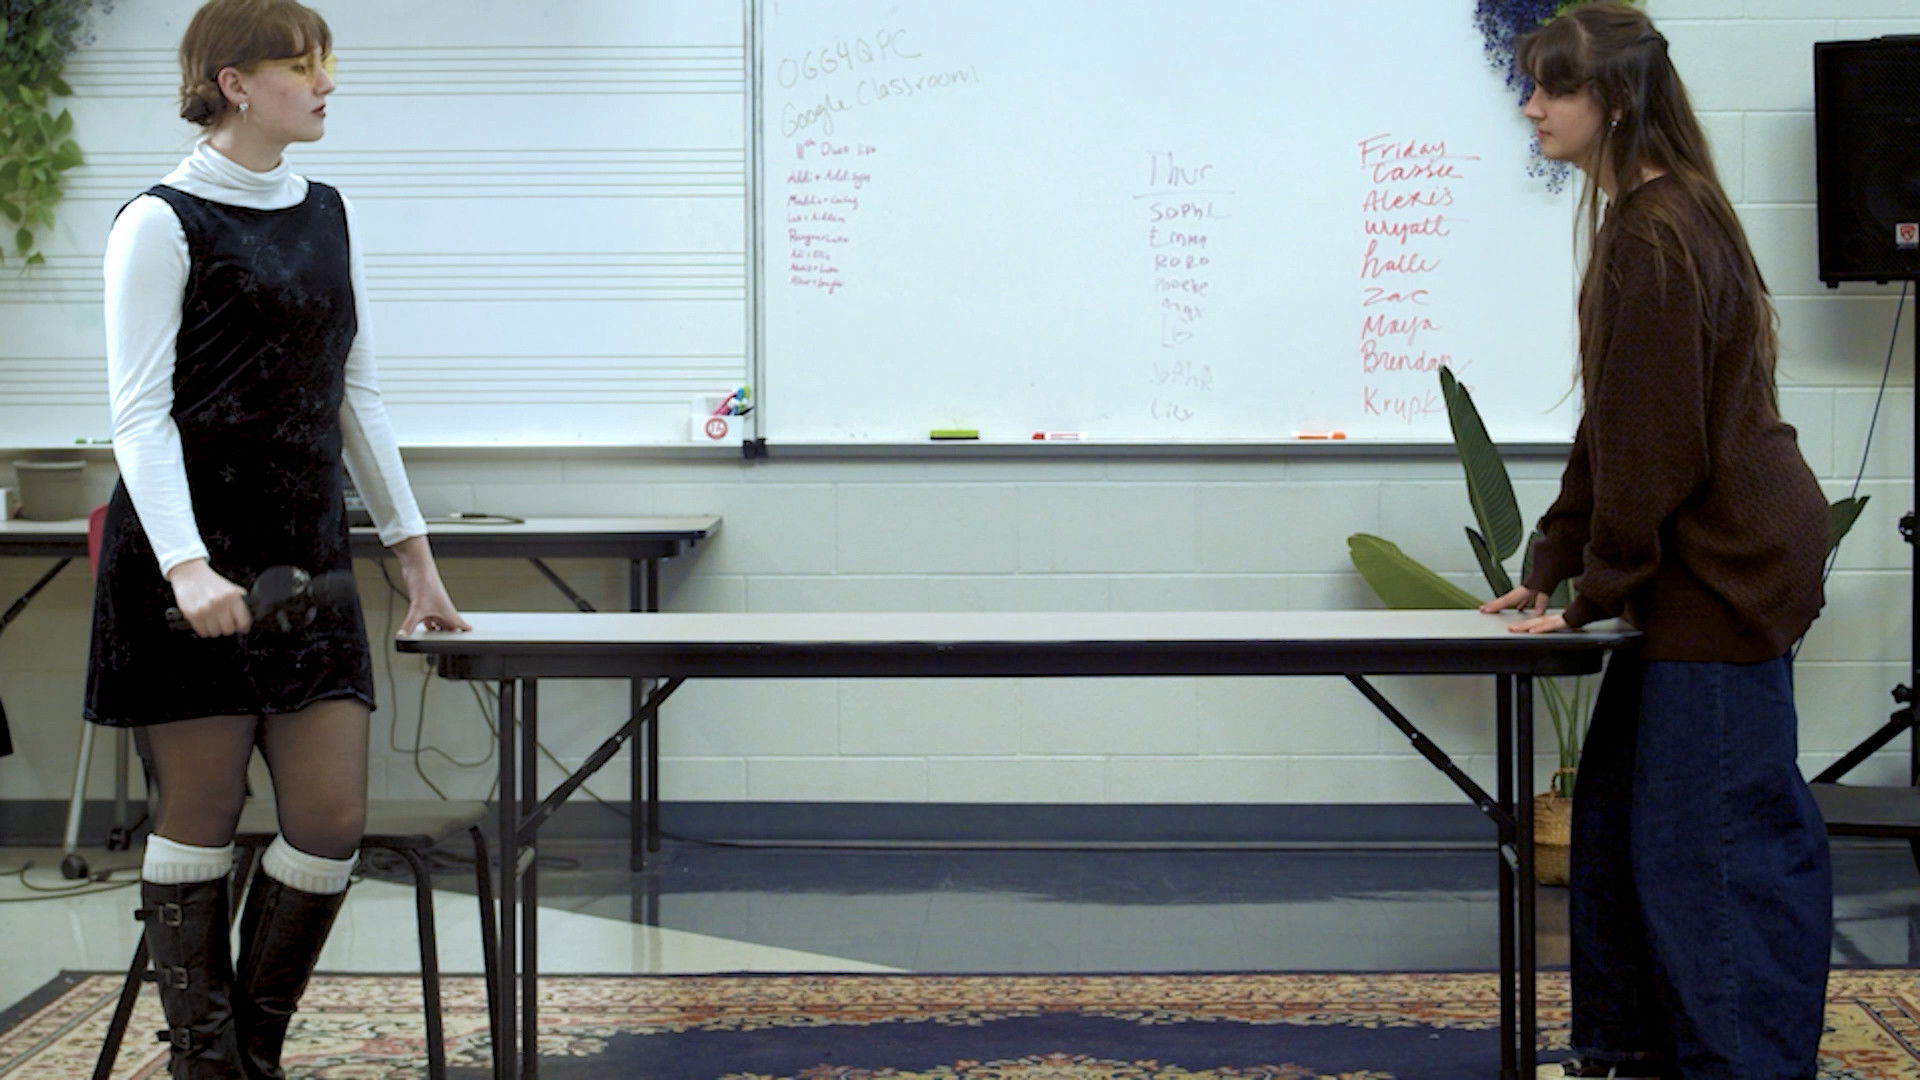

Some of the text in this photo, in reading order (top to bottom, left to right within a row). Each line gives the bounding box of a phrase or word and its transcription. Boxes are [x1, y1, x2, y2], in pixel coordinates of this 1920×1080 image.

[781, 63, 980, 138] Google Classroom
[1143, 149, 1214, 187] Thur
[1358, 131, 1446, 170] Friday
[1372, 161, 1464, 184] Cassie
[1362, 186, 1454, 212] Alexis
[1360, 313, 1443, 347] Maya
[1359, 339, 1453, 374] Brendan
[1363, 384, 1448, 425] Krupk
